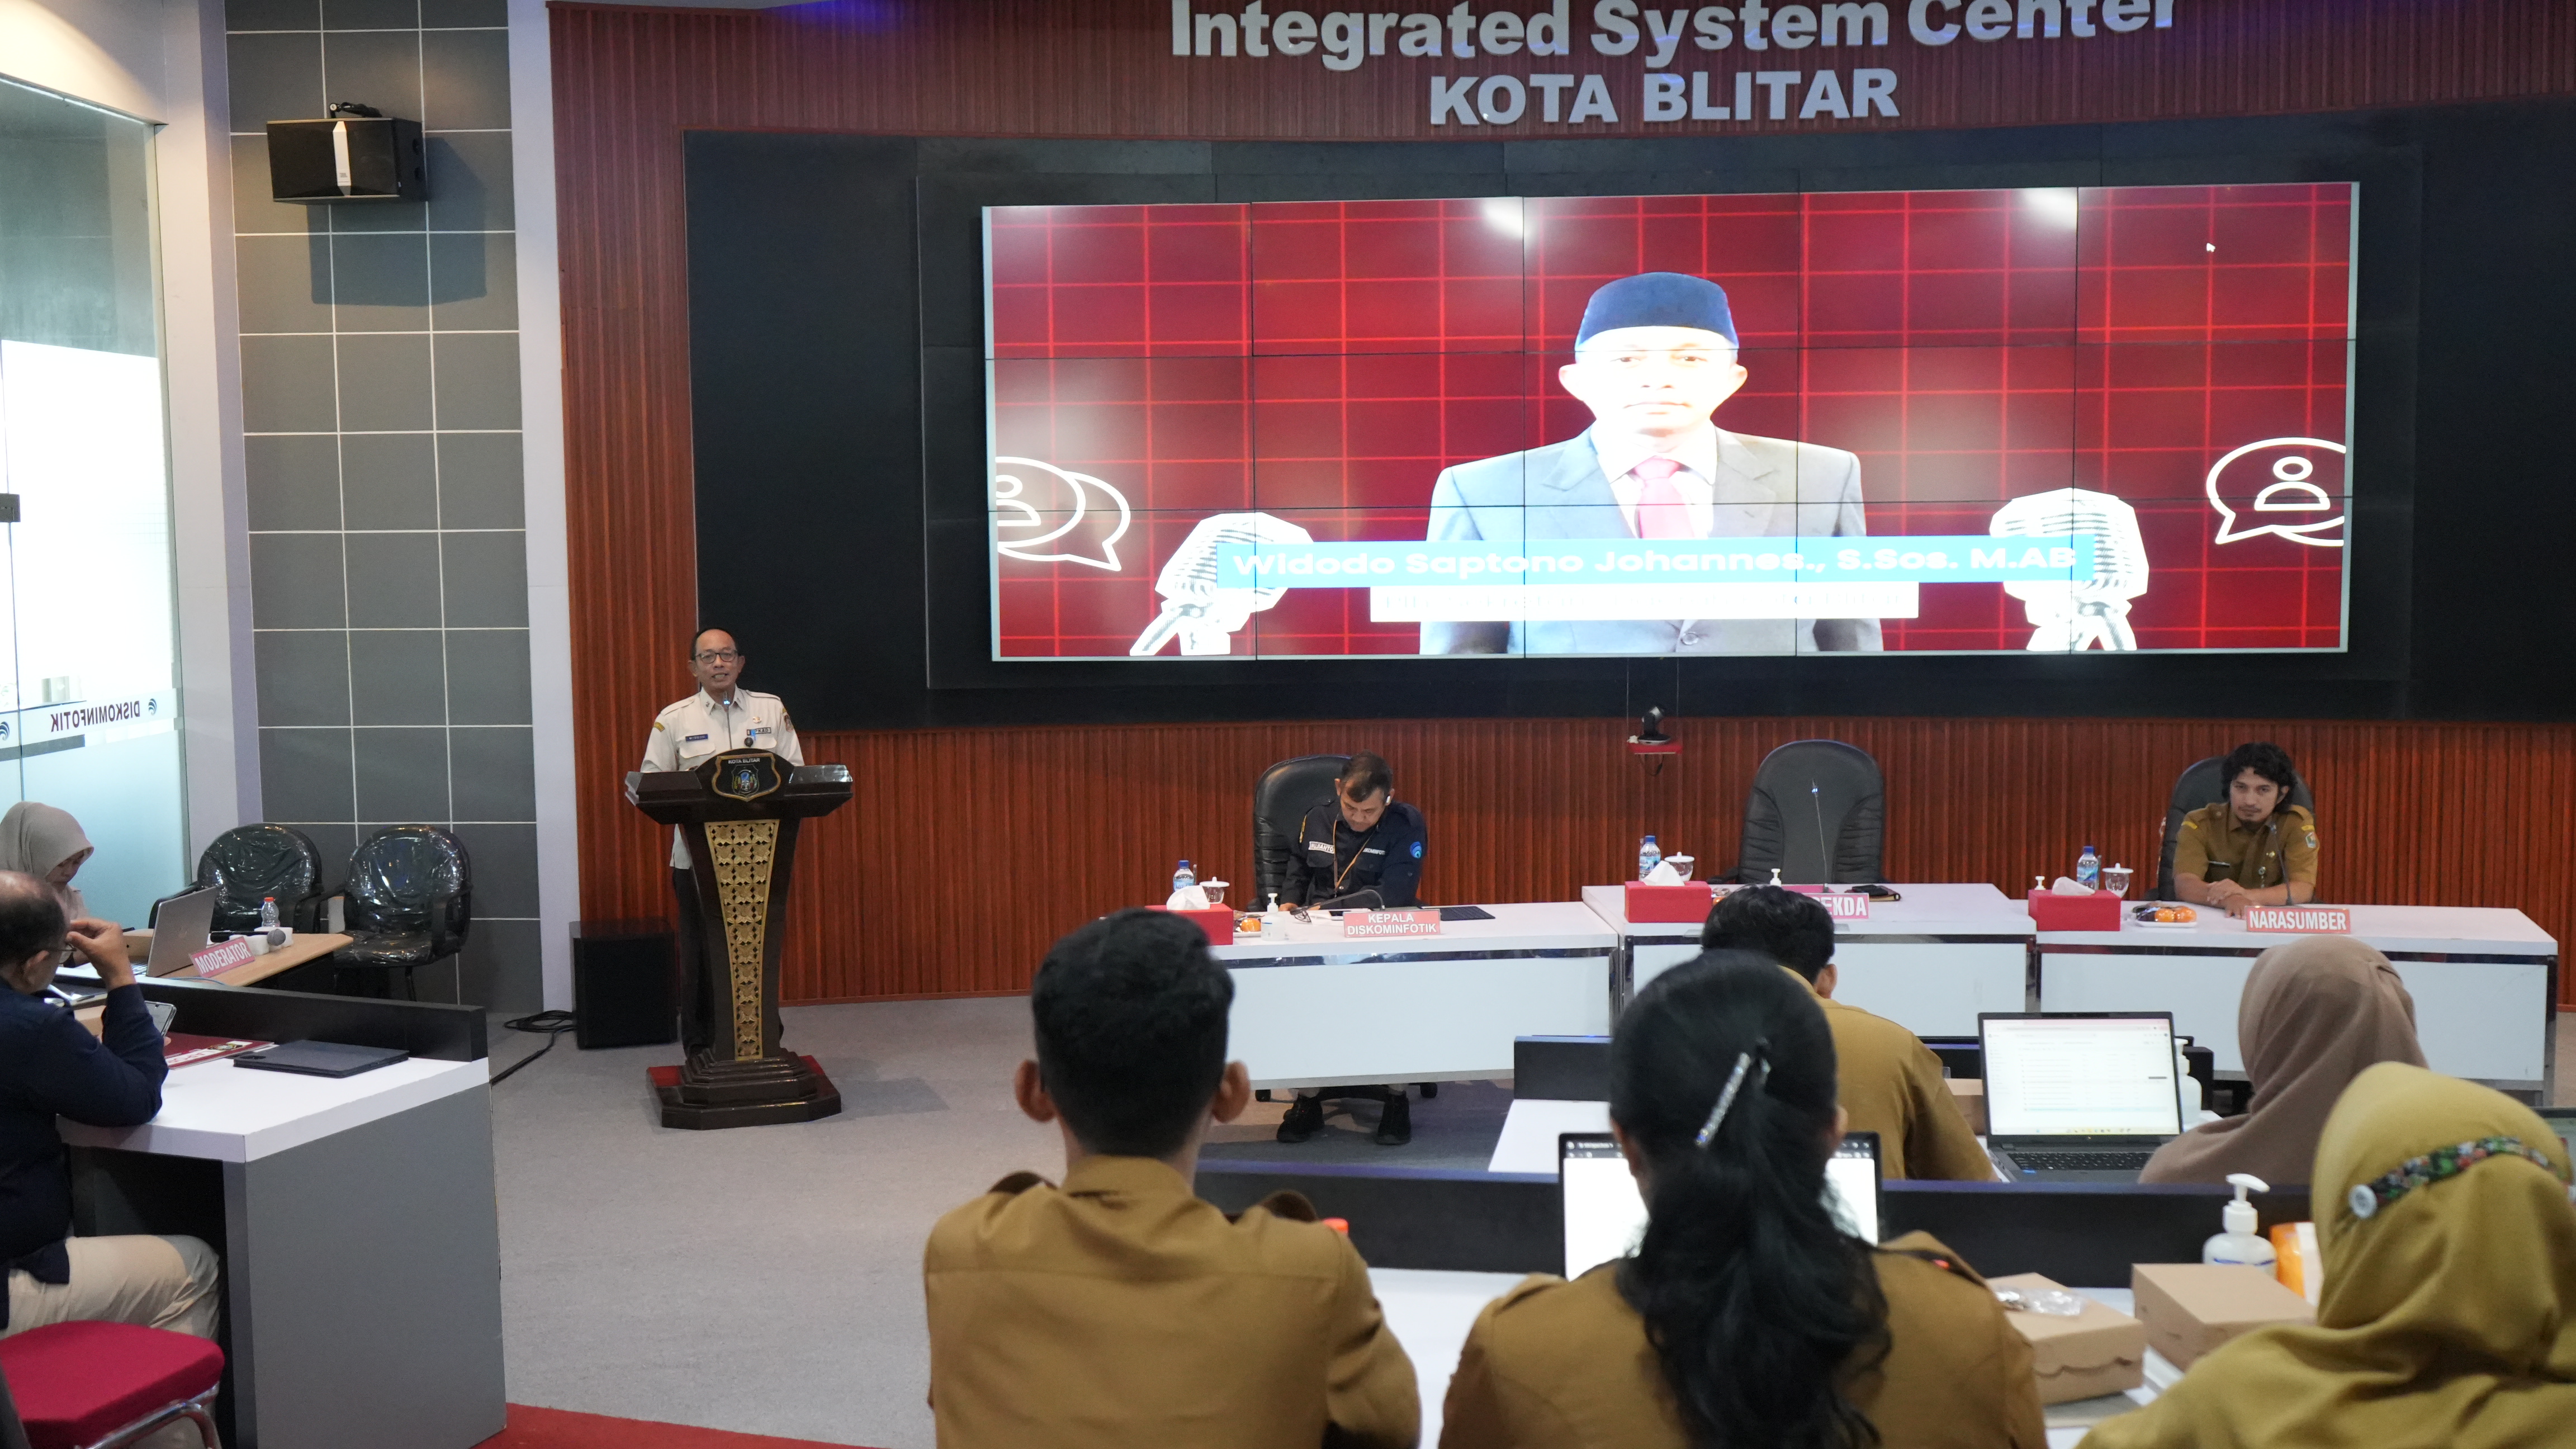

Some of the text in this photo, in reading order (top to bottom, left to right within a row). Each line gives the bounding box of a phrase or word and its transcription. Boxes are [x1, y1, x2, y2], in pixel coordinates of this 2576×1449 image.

[1171, 0, 2176, 71] Integrated System Center
[1430, 68, 1901, 126] KOTA BLITAR
[1233, 553, 1396, 576] Widodo
[1405, 553, 1585, 579] Saptono
[1594, 550, 1826, 573] Johannes.,
[1971, 547, 2076, 569] M.AB
[1368, 913, 1414, 924] KEPALA
[1812, 897, 1867, 916] EKDA
[1347, 923, 1437, 935] DISKOMINFOTIK
[2250, 910, 2347, 930] NARASUMBER
[195, 942, 251, 974] MODERATOR
